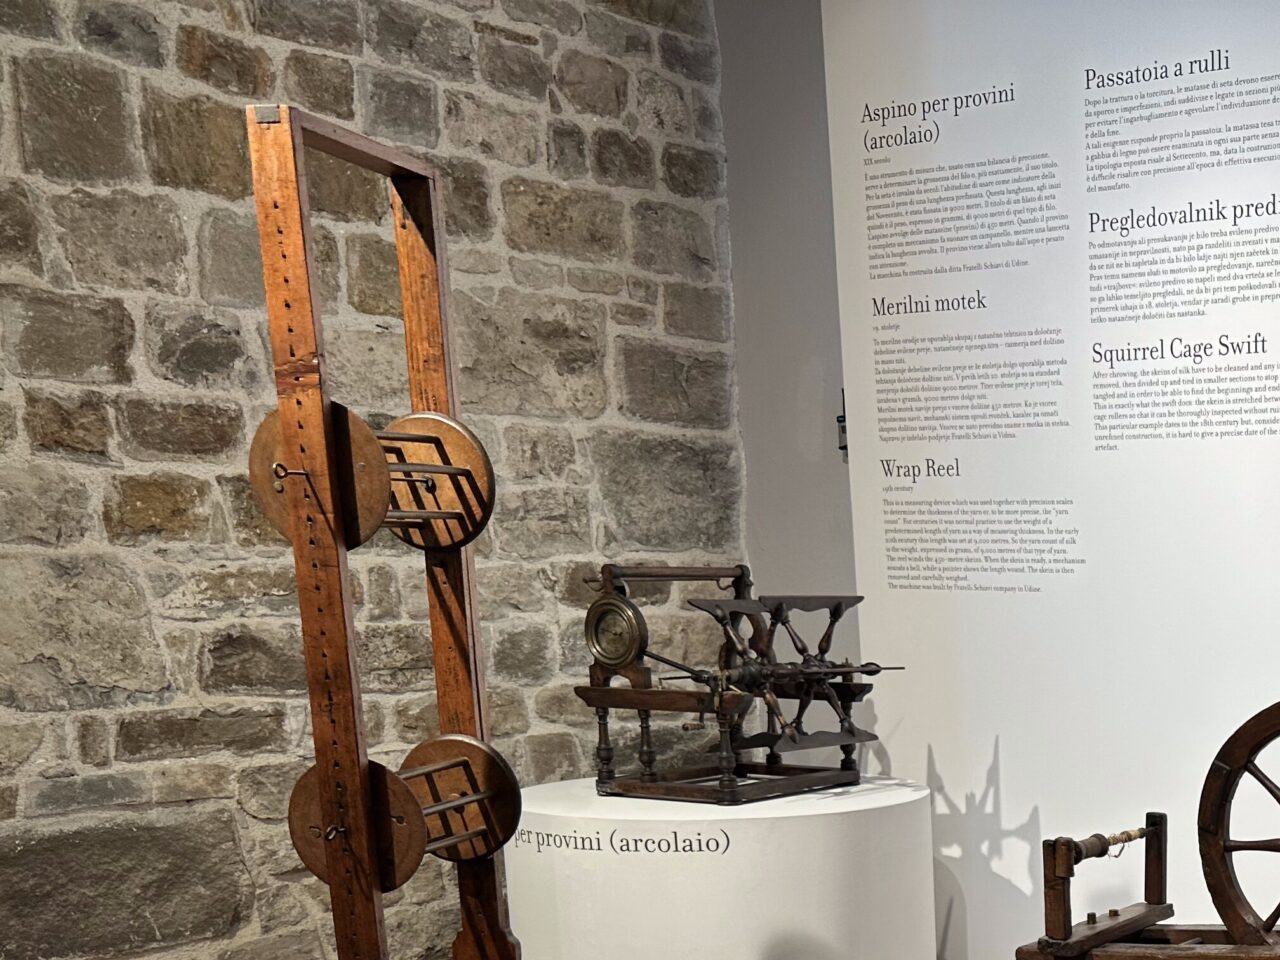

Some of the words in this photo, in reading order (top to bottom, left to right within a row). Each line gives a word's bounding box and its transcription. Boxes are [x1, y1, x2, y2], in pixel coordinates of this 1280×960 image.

[1084, 60, 1169, 90] Passatoia
[1173, 62, 1184, 77] a
[1188, 49, 1231, 75] rulli
[860, 100, 917, 127] Aspino
[921, 96, 950, 121] per
[953, 82, 1015, 117] provini
[863, 120, 940, 153] (arcolaio)
[1088, 202, 1228, 238] Pregledovalnik
[871, 297, 931, 318] Merilni
[934, 290, 987, 313] motek
[1092, 340, 1165, 369] Squirrel
[1170, 337, 1213, 364] Cage
[1218, 333, 1268, 356] Swift
[880, 459, 921, 483] Wrap
[925, 458, 961, 478] Reel
[514, 826, 533, 848] per
[536, 830, 603, 852] provini
[609, 828, 731, 855] (arcolaio)
